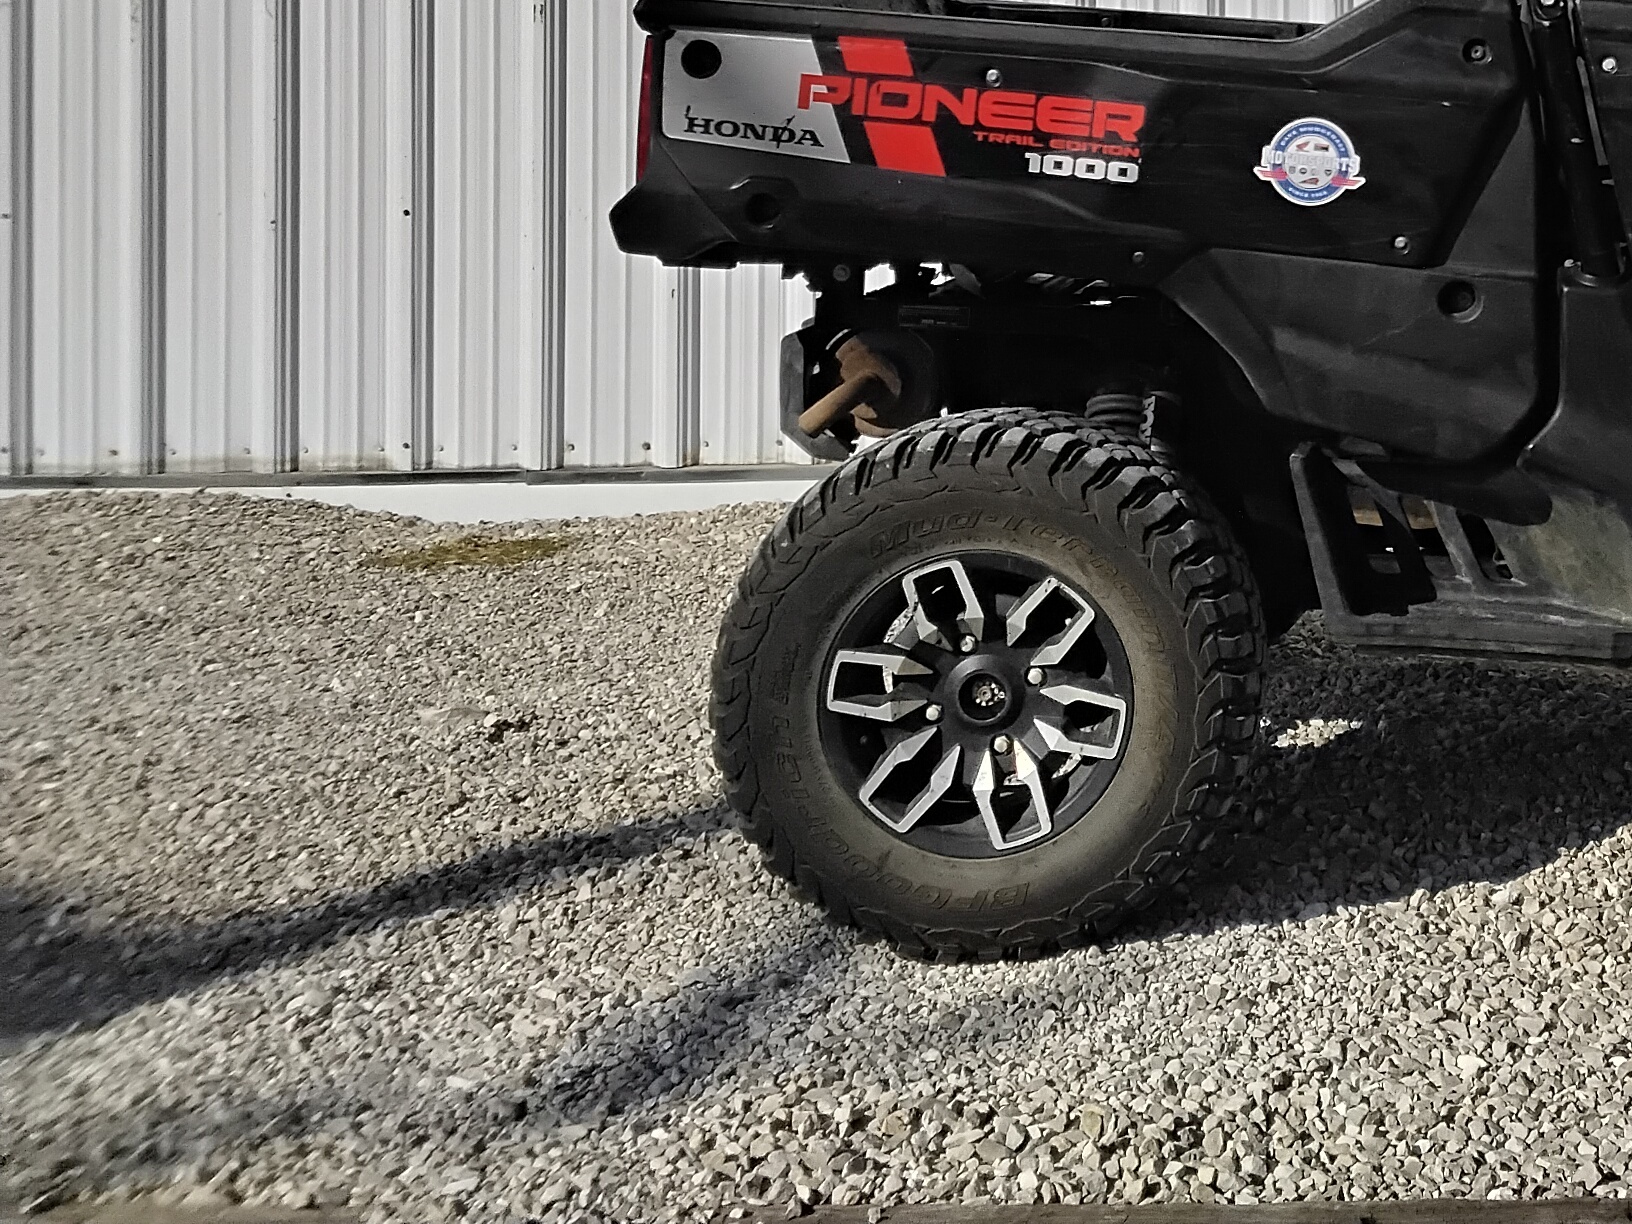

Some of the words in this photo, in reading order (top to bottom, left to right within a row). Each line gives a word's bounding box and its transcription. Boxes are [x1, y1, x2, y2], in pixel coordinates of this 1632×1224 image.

[797, 74, 1147, 143] PIONEER
[683, 114, 825, 148] HONDA
[973, 131, 1044, 147] TRAIL
[1049, 138, 1141, 158] EDITION
[1024, 152, 1139, 183] 1000
